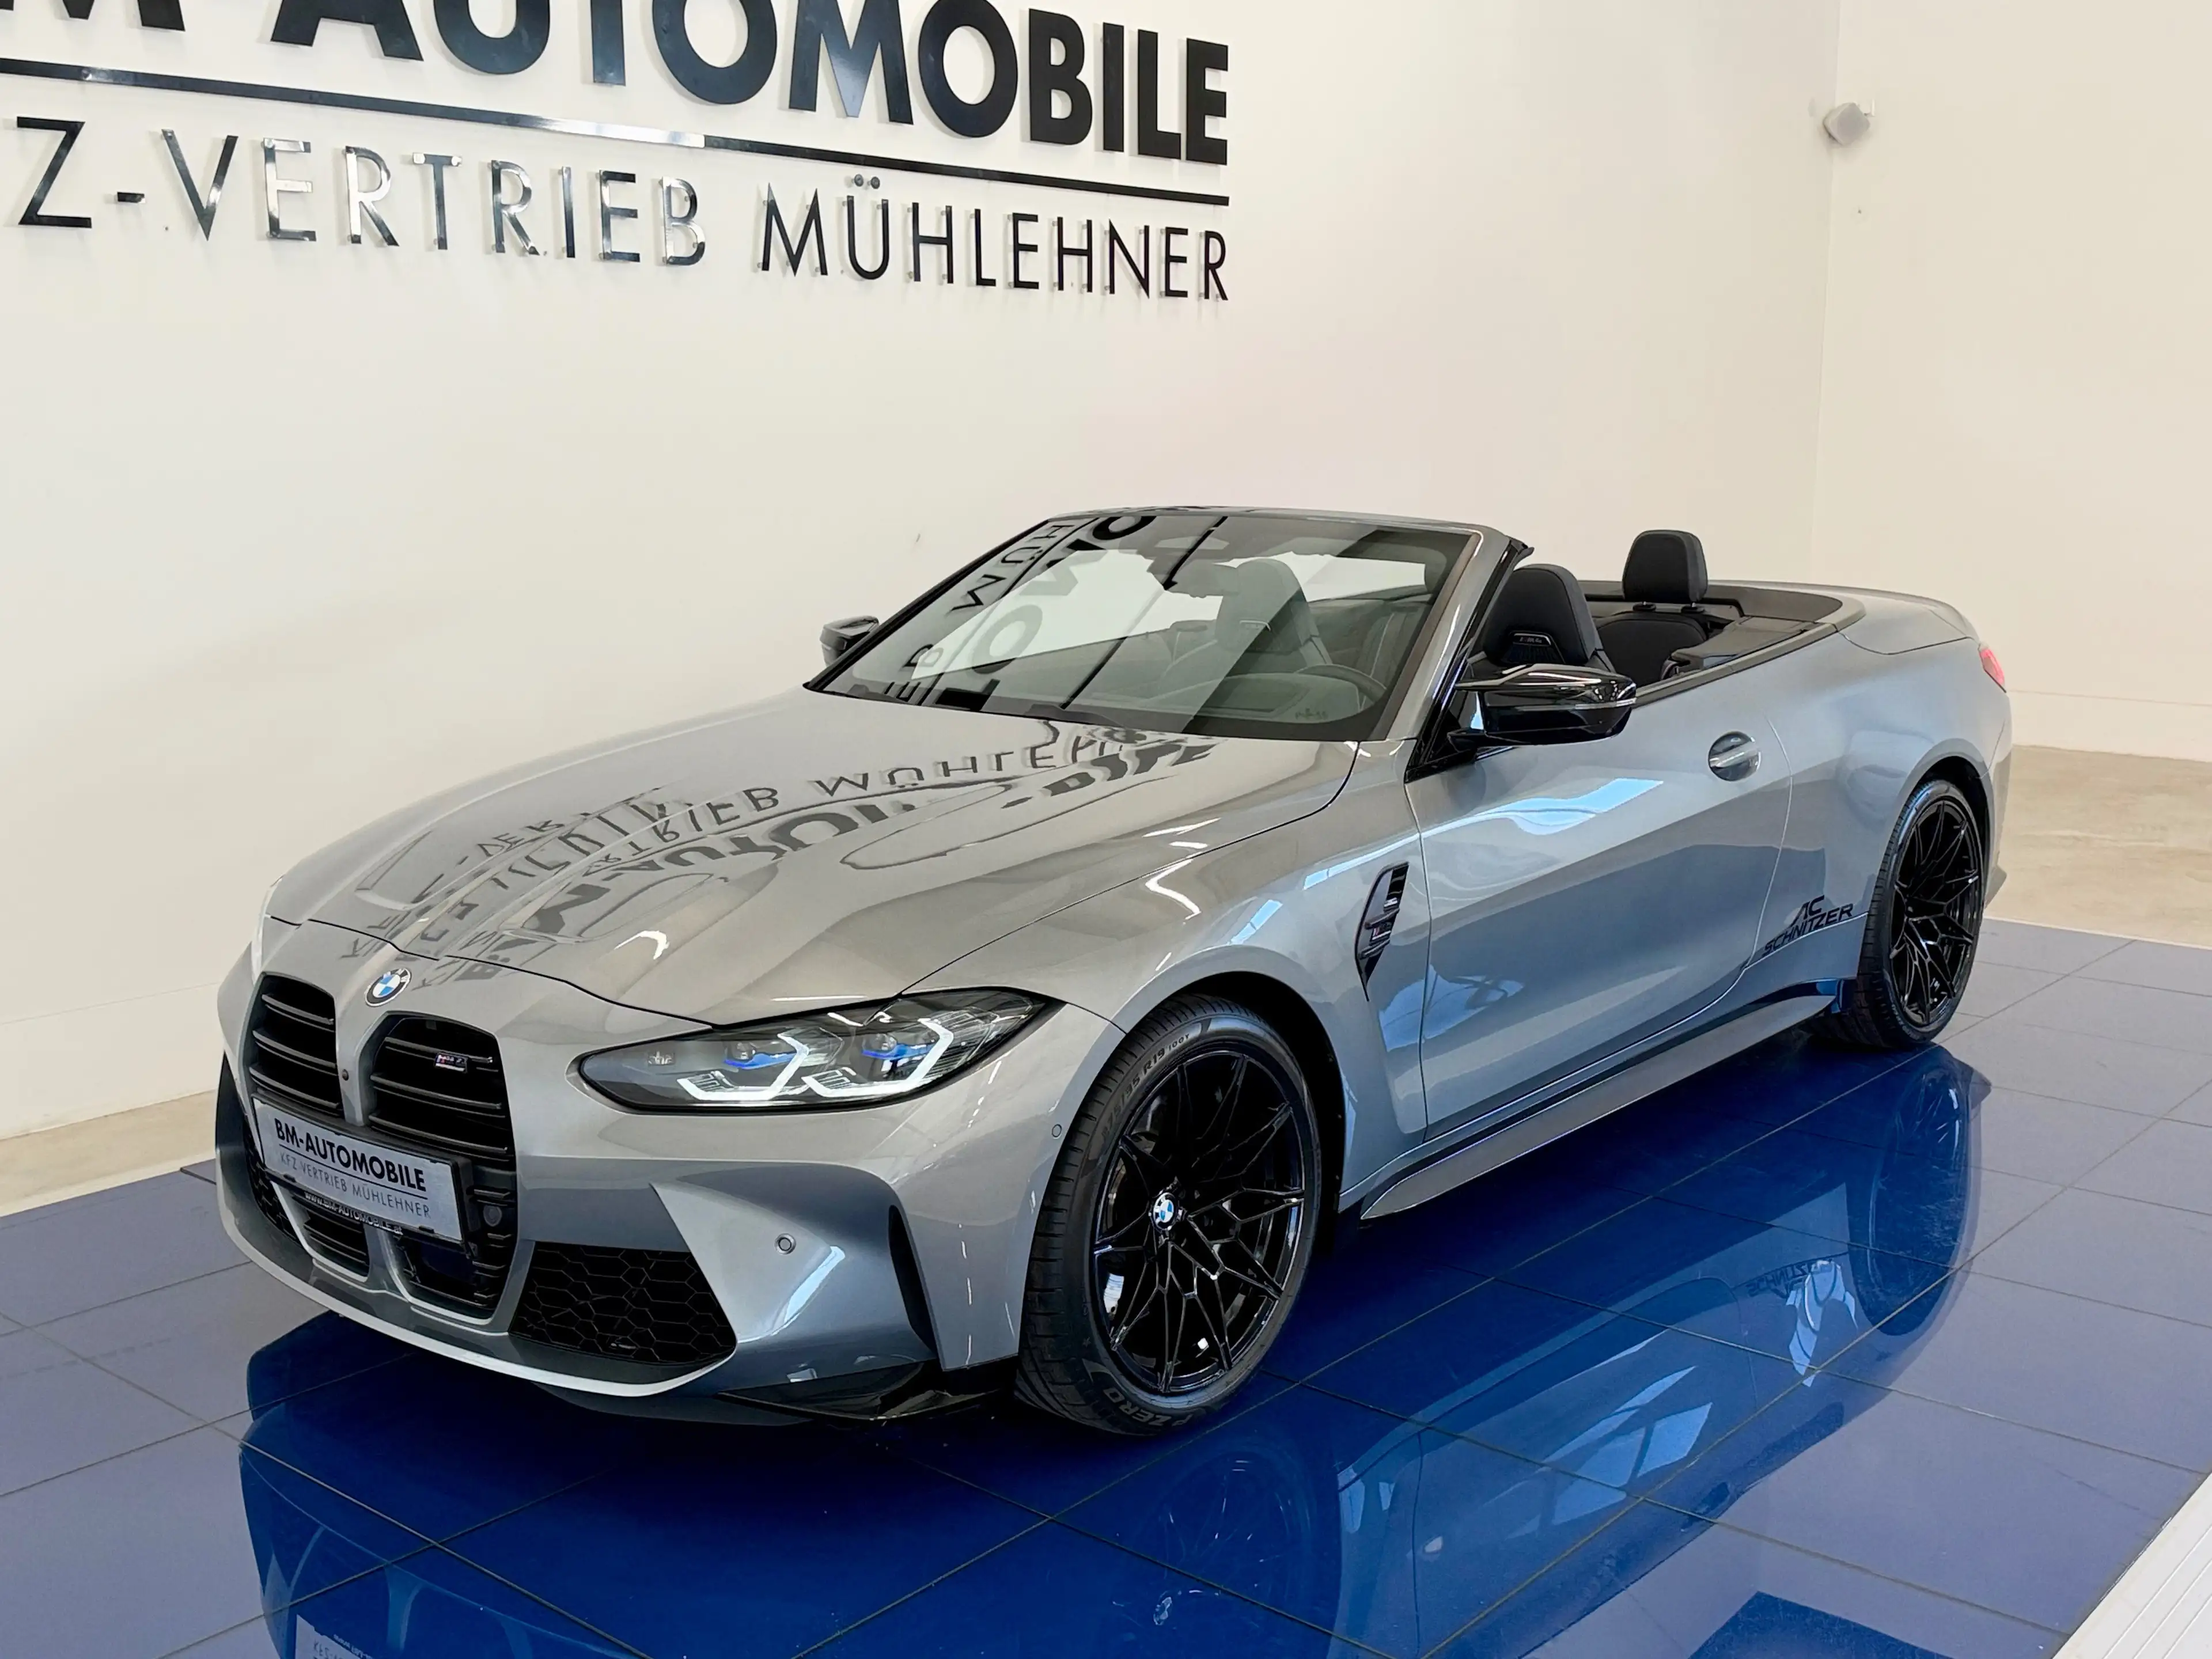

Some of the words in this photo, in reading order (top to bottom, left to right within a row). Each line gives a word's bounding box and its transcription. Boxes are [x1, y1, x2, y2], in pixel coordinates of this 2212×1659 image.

[16, 116, 706, 266] Z-VERTRIEB
[762, 173, 1229, 301] MÜHLEHNER
[1762, 903, 1853, 957] SCHNITZER
[1790, 895, 1824, 927] AC
[1143, 1047, 1165, 1075] R19
[274, 1118, 427, 1192] BM-AUTOMOBILE
[352, 1183, 431, 1220] MÜHLEHNER
[1102, 1387, 1173, 1427] ZERO
